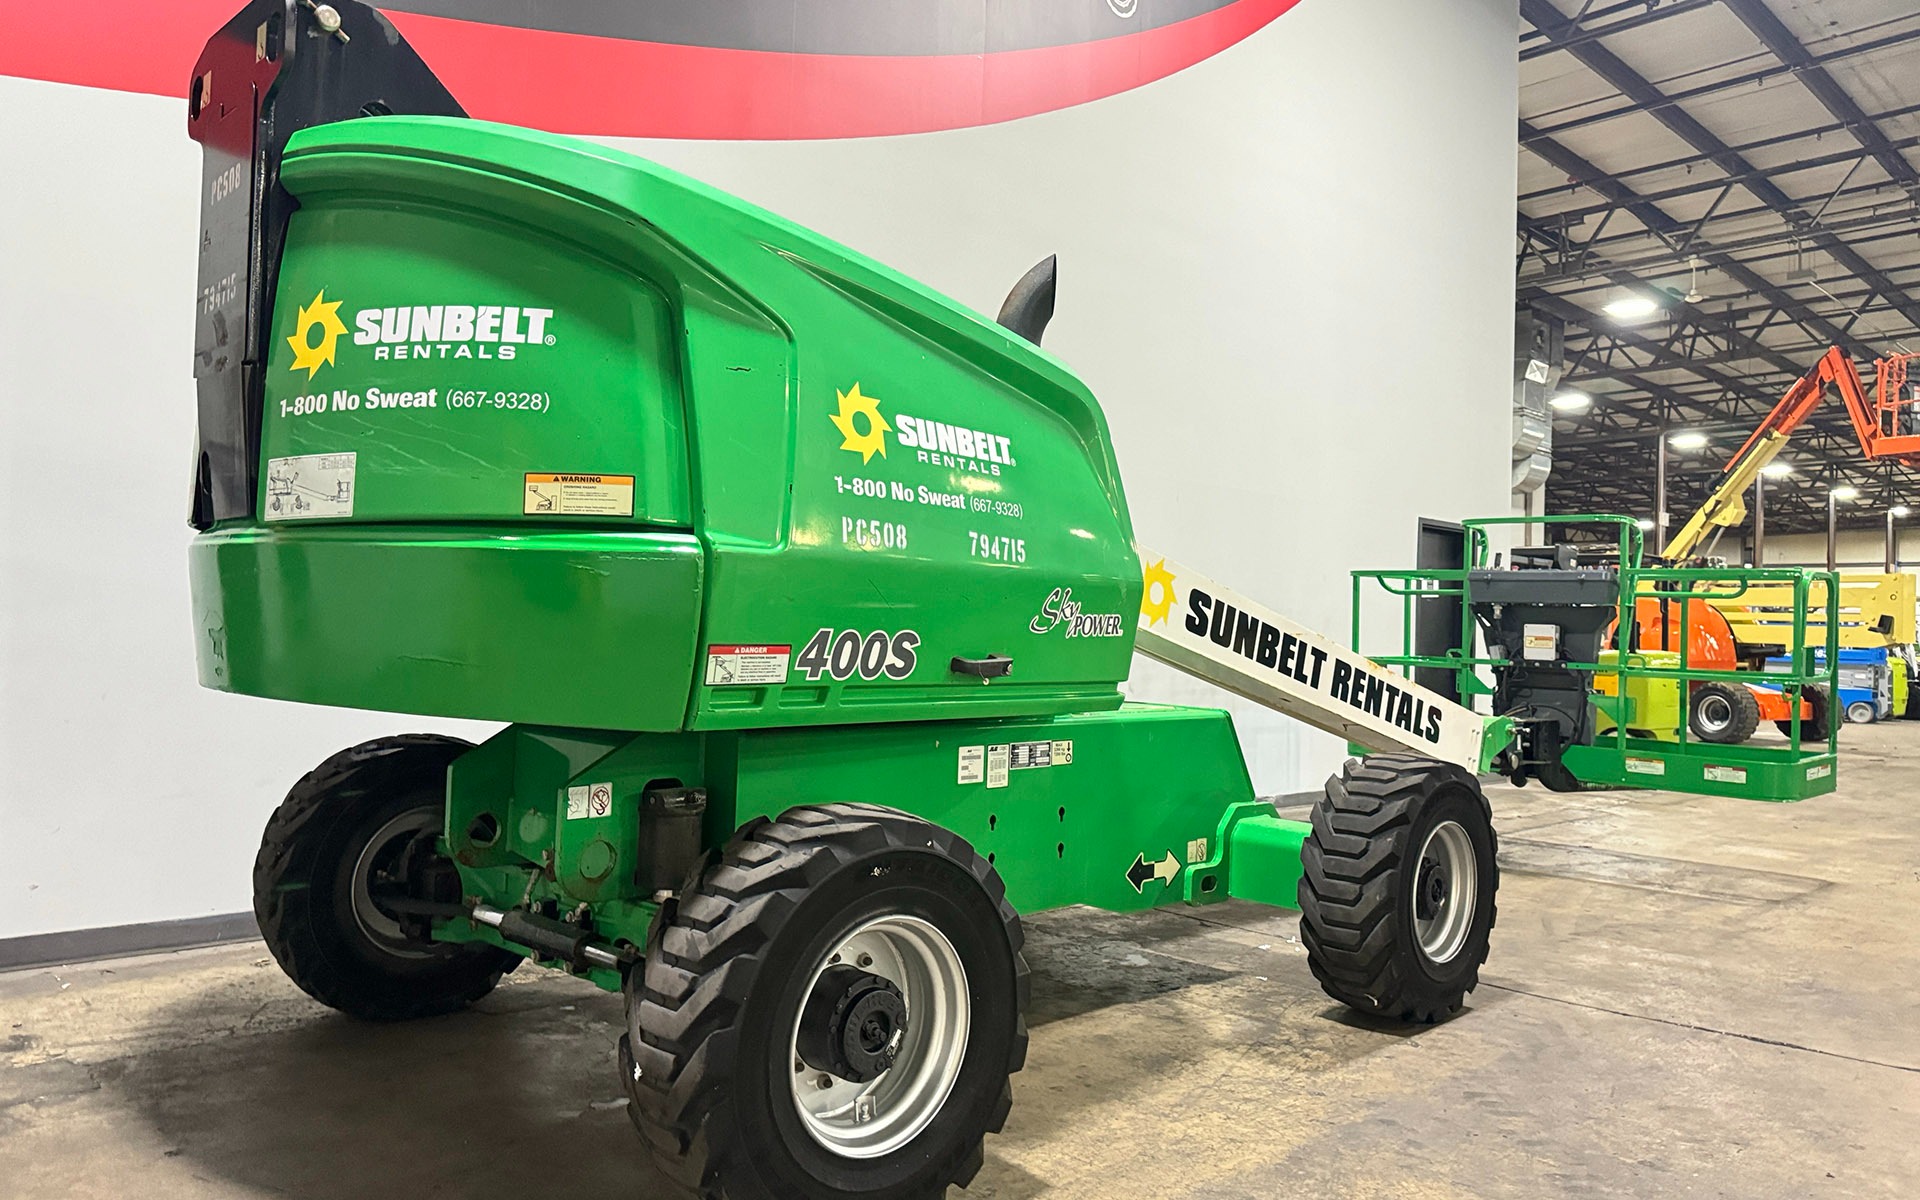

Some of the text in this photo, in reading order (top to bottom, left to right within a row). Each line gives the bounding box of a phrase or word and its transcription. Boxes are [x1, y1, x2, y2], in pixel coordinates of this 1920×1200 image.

[210, 162, 241, 207] PC508
[203, 272, 237, 315] 794715
[374, 344, 516, 361] RENTALS
[279, 387, 551, 418] 1-800 No Sweat (667-9328)
[561, 475, 602, 484] WARNING
[916, 449, 1001, 476] RENTALS
[834, 475, 1024, 520] 1-800 No Sweat (667-9328)
[841, 515, 908, 550] PC508
[968, 530, 1027, 564] 794715
[1029, 587, 1123, 639] Sky POWER
[740, 646, 768, 654] DANGER
[794, 627, 921, 681] 400S
[1185, 588, 1442, 745] SUNBELT RENTALS
